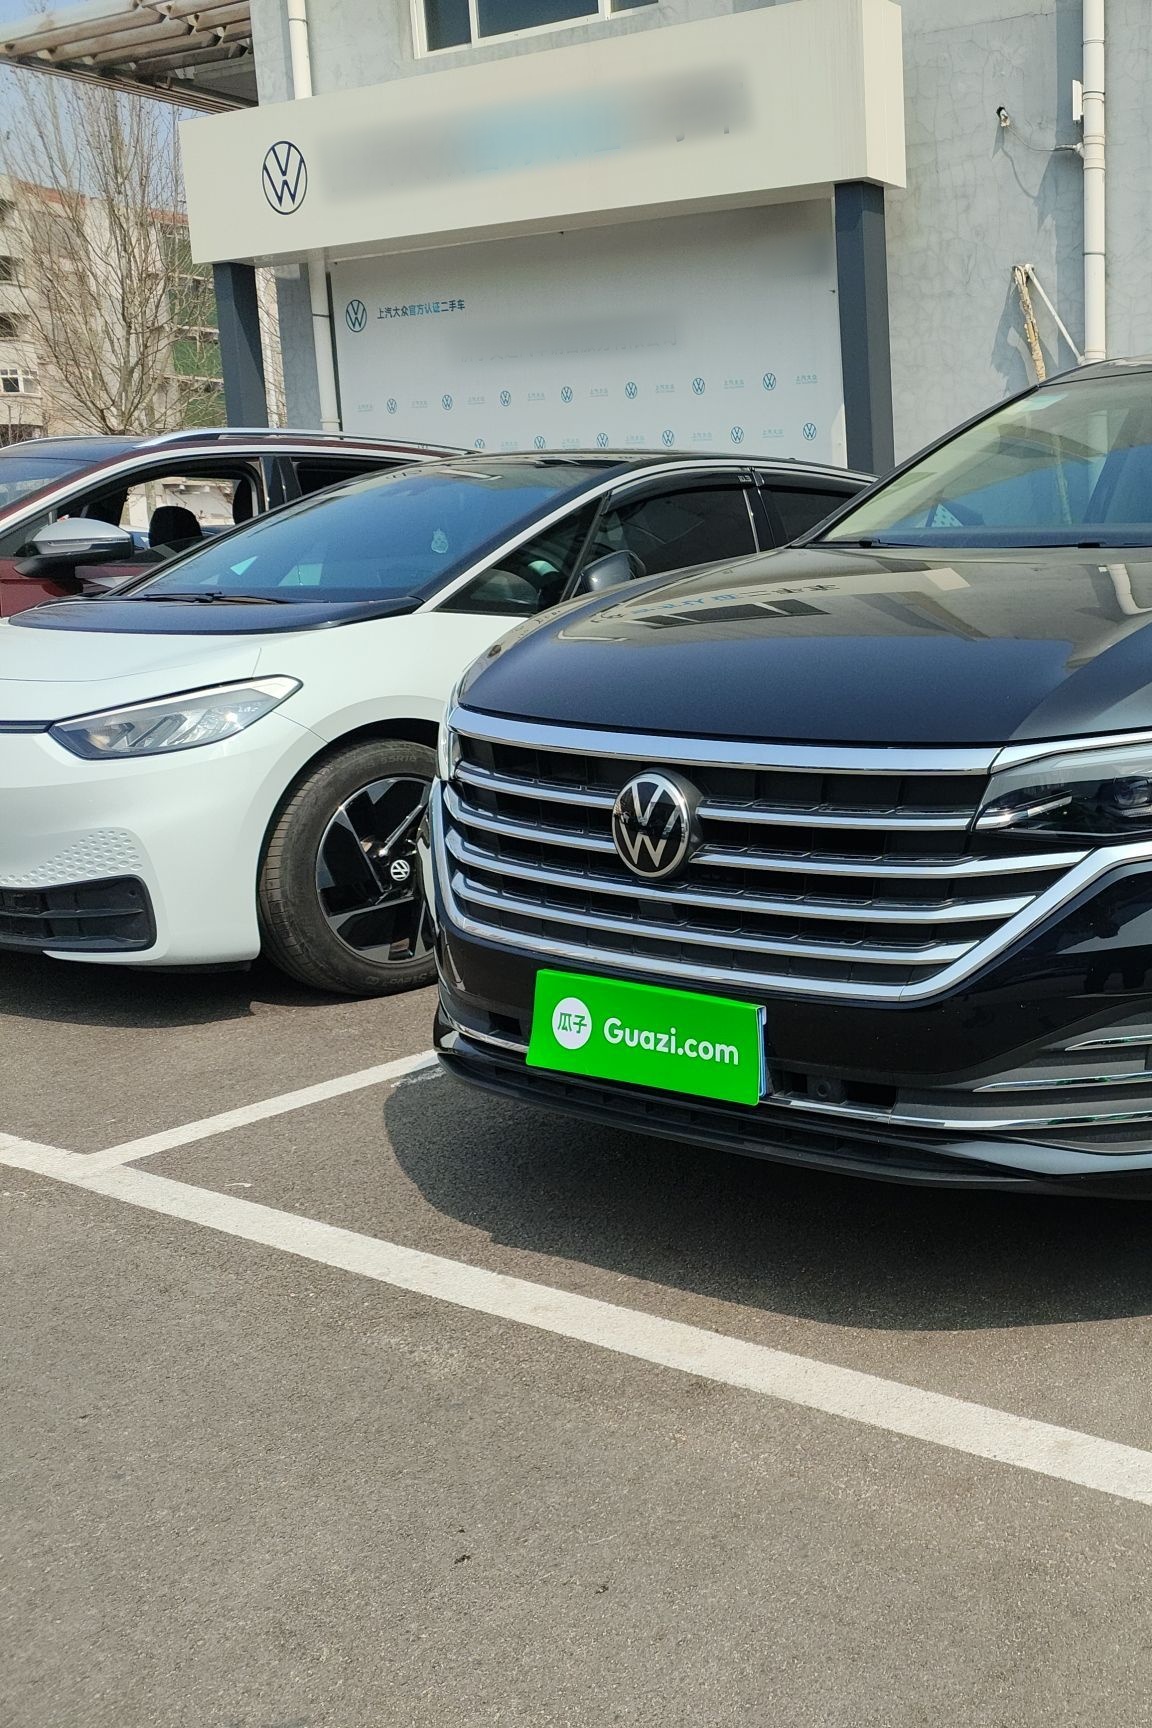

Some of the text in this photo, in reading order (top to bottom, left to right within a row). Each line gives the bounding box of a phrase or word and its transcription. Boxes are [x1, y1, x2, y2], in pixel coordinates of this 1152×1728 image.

[262, 141, 308, 215] VW
[377, 299, 465, 319] 上汽大众官方认证二手车
[613, 773, 690, 877] VW
